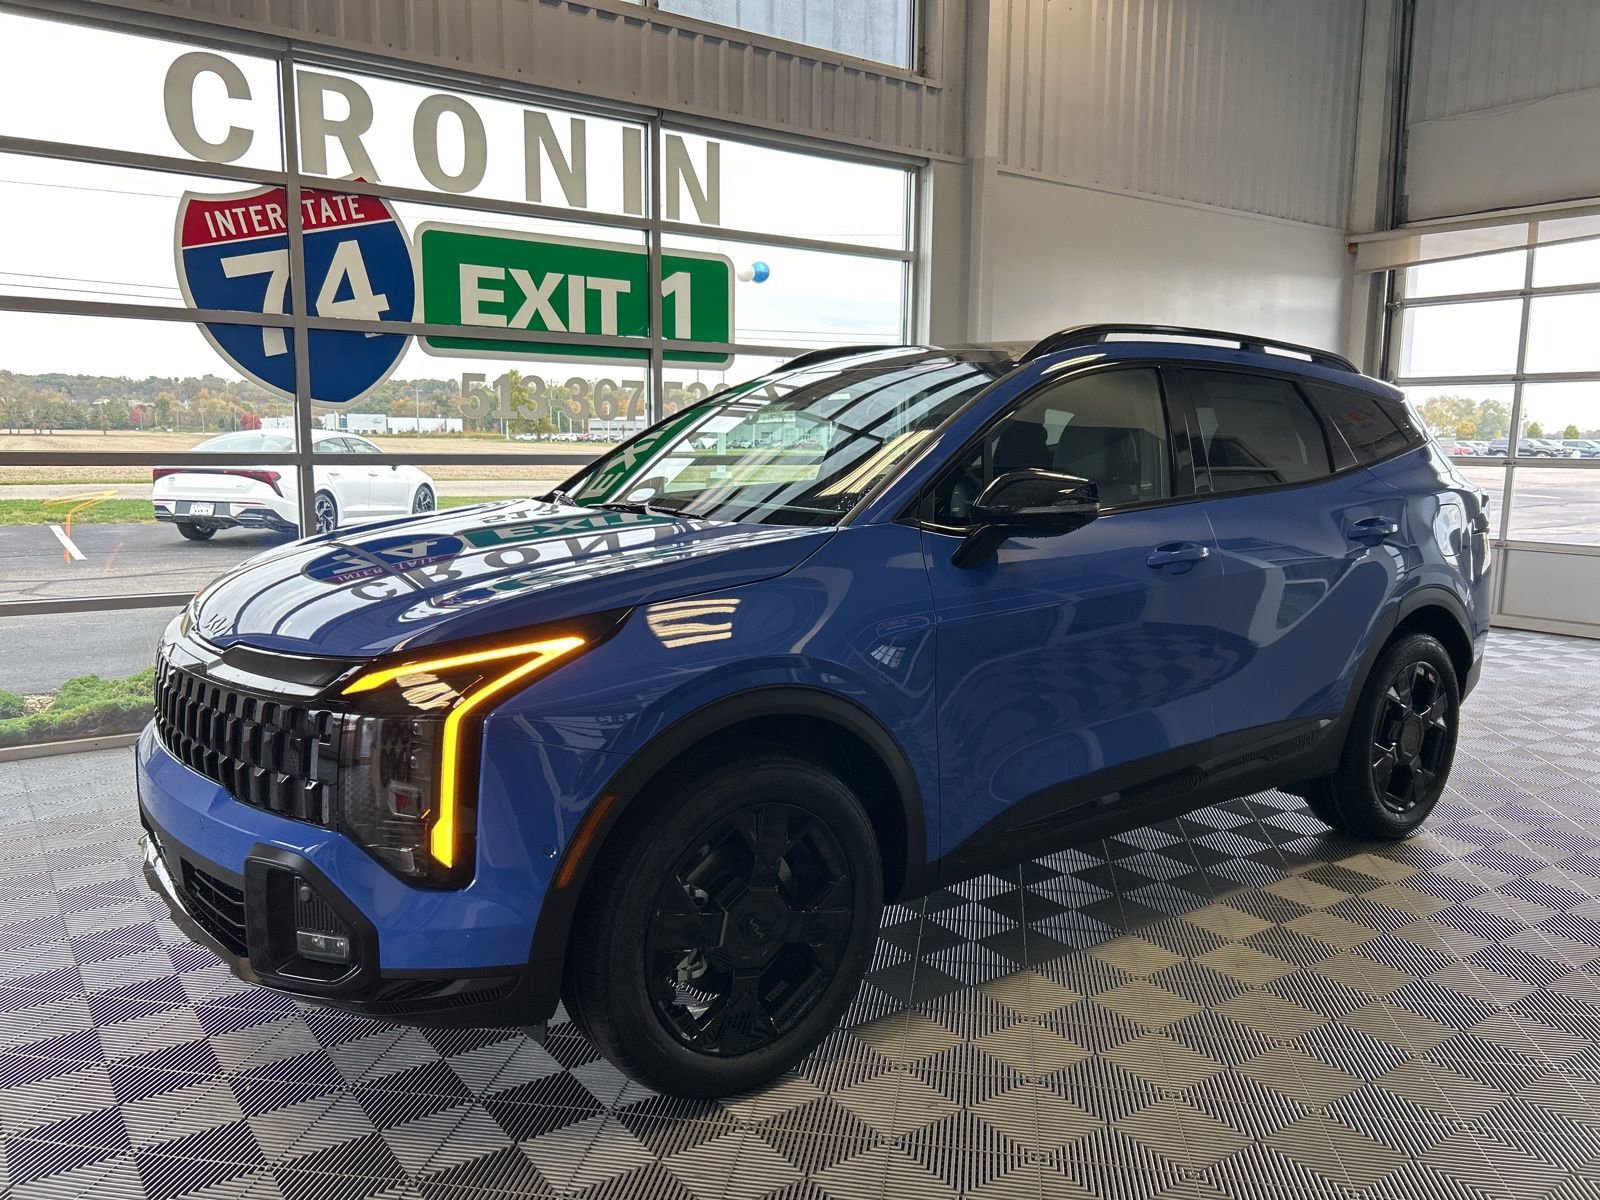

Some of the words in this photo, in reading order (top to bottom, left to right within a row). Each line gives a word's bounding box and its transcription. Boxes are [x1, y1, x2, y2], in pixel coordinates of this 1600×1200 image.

[163, 51, 720, 226] CRONIN
[204, 195, 365, 238] INTERTATE
[221, 239, 390, 357] 74
[459, 263, 631, 336] EXIT
[661, 271, 691, 340] 1
